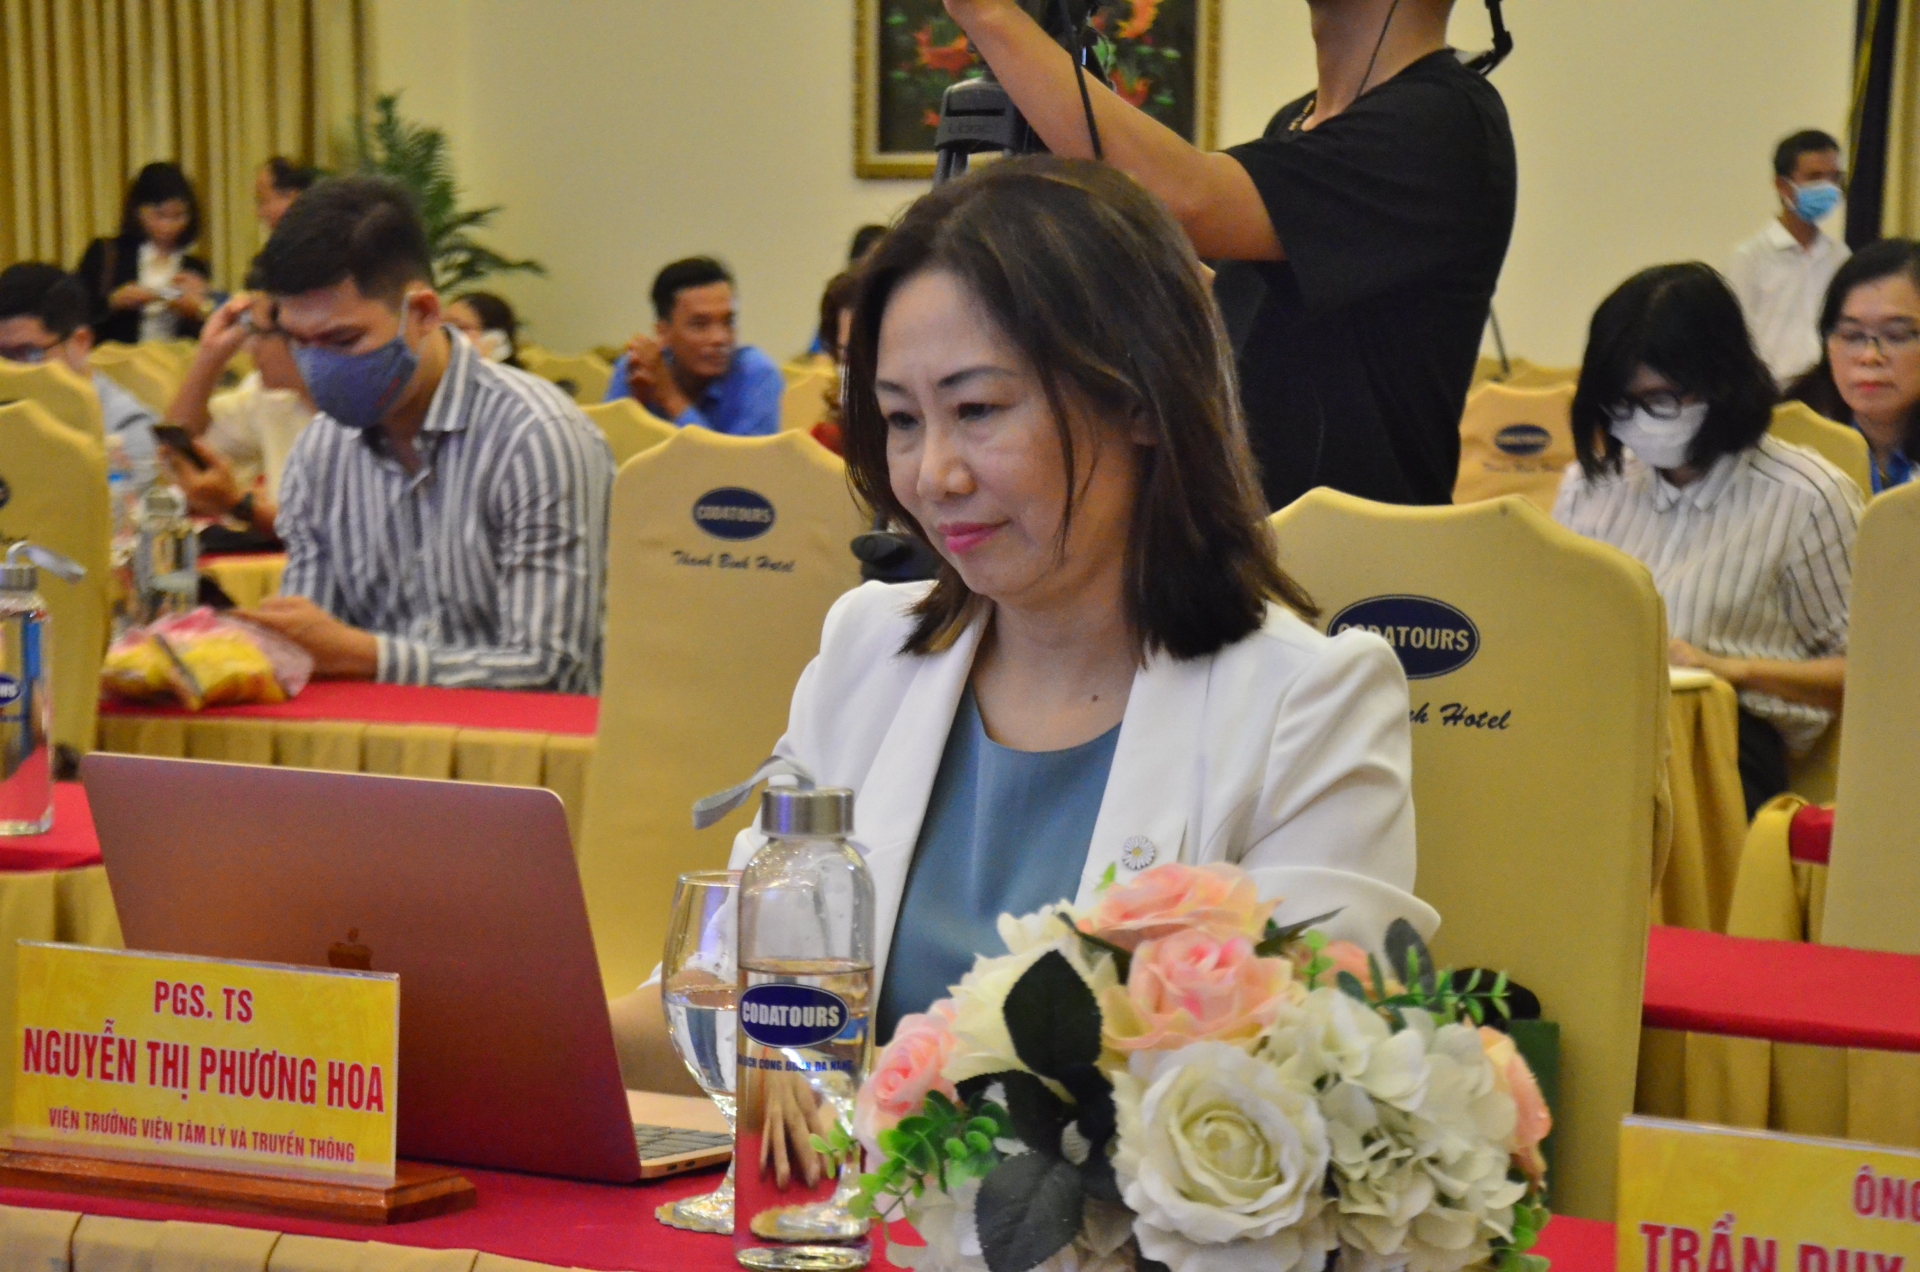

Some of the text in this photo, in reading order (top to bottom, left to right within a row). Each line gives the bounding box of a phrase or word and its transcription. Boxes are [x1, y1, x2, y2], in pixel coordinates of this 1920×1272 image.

[1338, 623, 1469, 651] ATOURS
[1440, 703, 1511, 730] Hotel
[154, 981, 253, 1023] PGS. TS
[742, 1001, 840, 1028] CODATOURS
[23, 1019, 384, 1112] NGUYỄN THỊ PHƯƠNG HOA
[177, 1119, 206, 1144] TÂM
[210, 1123, 225, 1147] LÝ
[230, 1126, 247, 1149] VÀ
[310, 1137, 355, 1163] THÔNG
